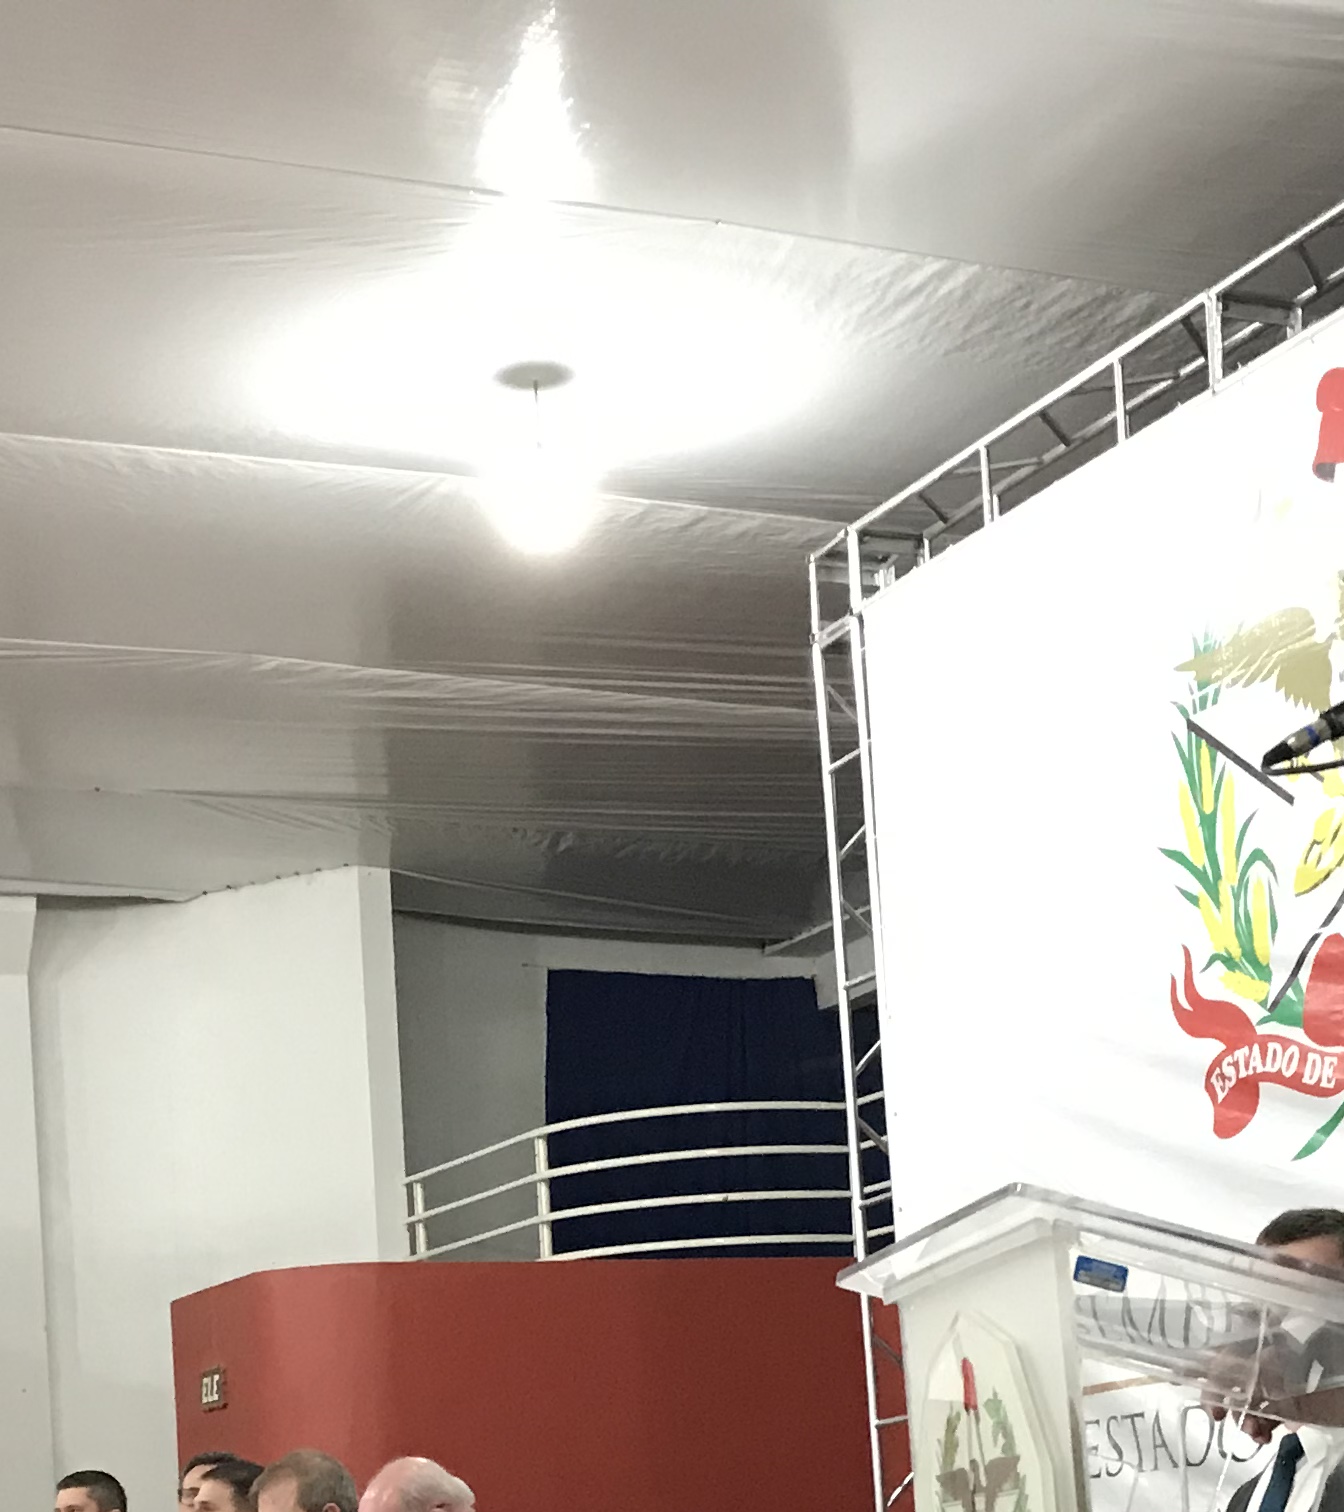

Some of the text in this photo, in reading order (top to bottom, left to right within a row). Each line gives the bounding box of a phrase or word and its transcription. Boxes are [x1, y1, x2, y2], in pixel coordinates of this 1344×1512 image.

[1210, 1040, 1299, 1104] ESTADO
[1301, 1049, 1339, 1089] DE
[1084, 1404, 1265, 1479] ESTADO
